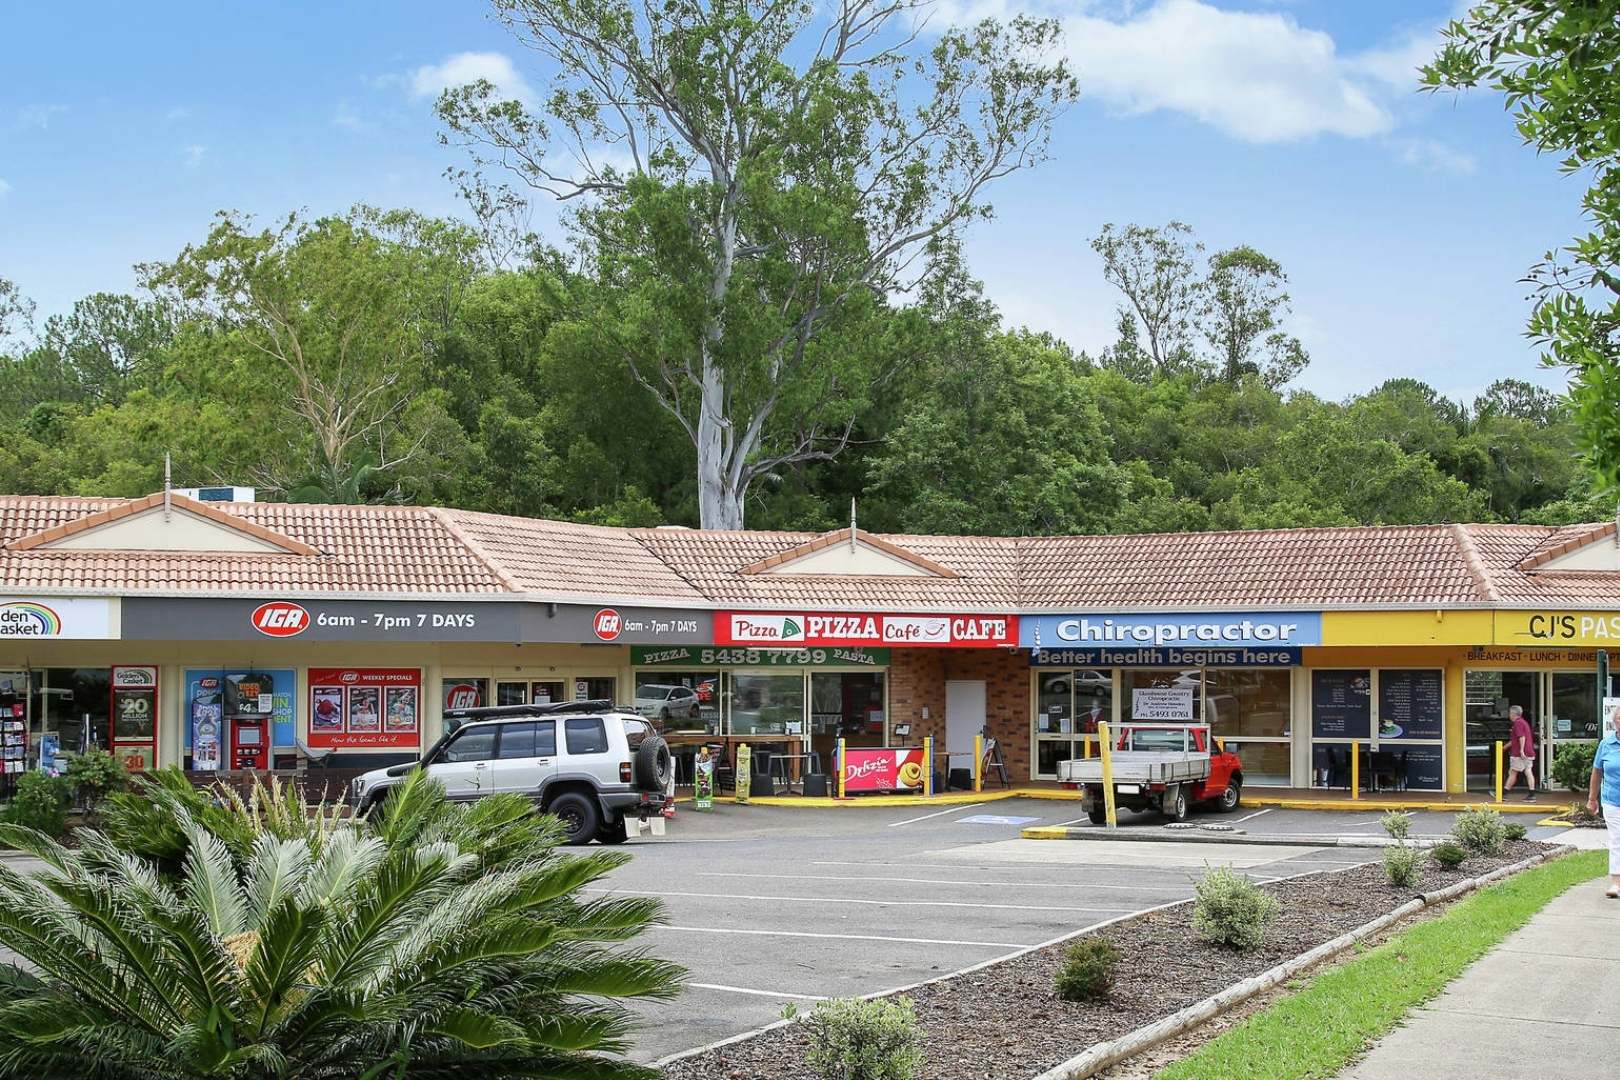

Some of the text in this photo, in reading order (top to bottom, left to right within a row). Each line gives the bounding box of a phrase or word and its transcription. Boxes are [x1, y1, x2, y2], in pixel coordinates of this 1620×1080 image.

[0, 610, 28, 622] den
[258, 608, 304, 628] IGA
[316, 612, 355, 627] 6am
[374, 613, 411, 630] 7pm
[416, 614, 427, 627] 7
[432, 614, 476, 628] DAYS
[597, 615, 619, 633] IGA
[0, 623, 39, 635] asket
[624, 619, 643, 631] 6am
[651, 620, 669, 634] 7pm
[670, 621, 676, 632] 7
[677, 620, 698, 632] DAYS
[735, 620, 779, 638] Pizza
[806, 616, 880, 638] PIZZA
[885, 623, 921, 640] Café
[952, 618, 1006, 640] CAFE
[1056, 619, 1297, 645] Chiropractor
[1529, 615, 1620, 639] CJ'S PAS
[643, 648, 691, 664] PIZZA
[701, 650, 827, 664] 5438 7799
[832, 649, 876, 664] PASTA
[1038, 648, 1291, 667] Better health begins here
[1467, 651, 1597, 662] BREAKFAST LUNCH DINNE
[451, 690, 477, 709] IGA
